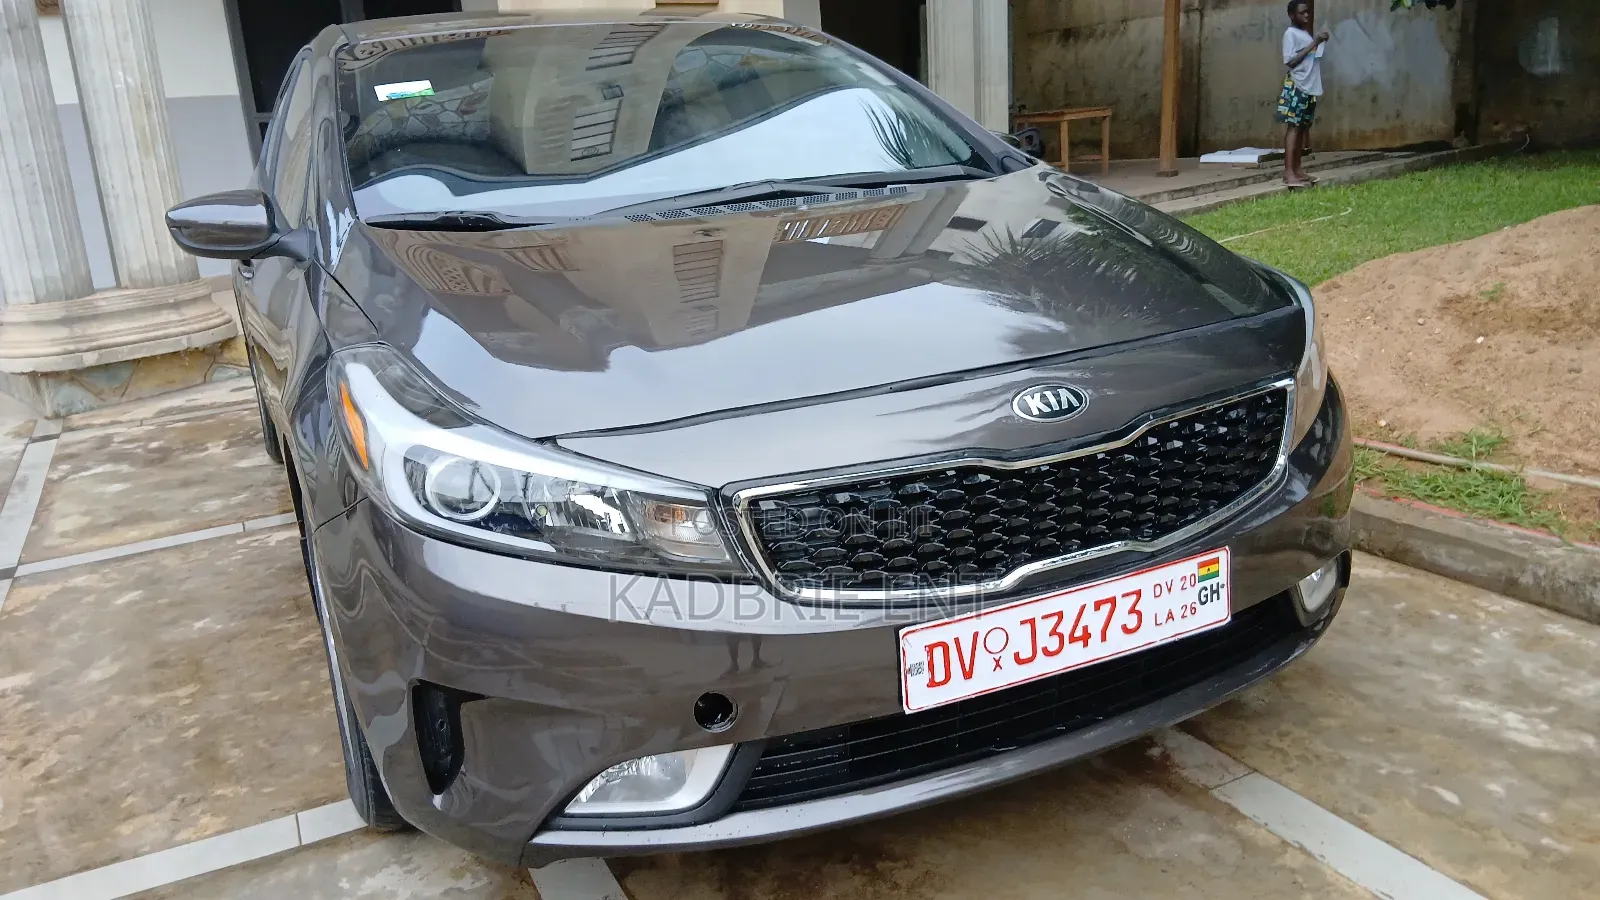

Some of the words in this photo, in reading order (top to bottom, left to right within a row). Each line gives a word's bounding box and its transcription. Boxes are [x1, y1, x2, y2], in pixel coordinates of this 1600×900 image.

[1023, 388, 1080, 416] KIA
[1153, 578, 1174, 598] DV
[1180, 573, 1197, 591] 20
[1198, 582, 1221, 606] GH
[1154, 608, 1175, 627] LA
[1180, 602, 1197, 619] 26
[924, 631, 979, 688] DV
[1013, 588, 1144, 666] J3473
